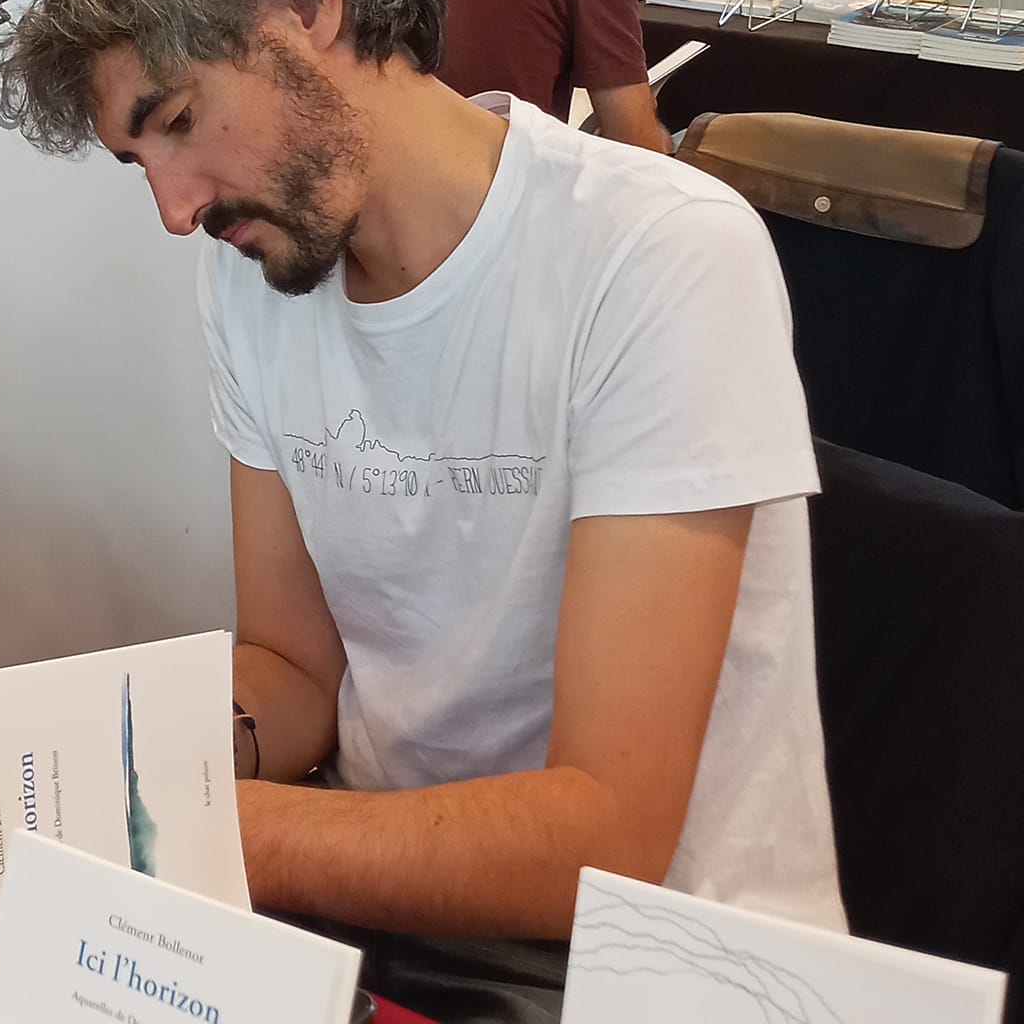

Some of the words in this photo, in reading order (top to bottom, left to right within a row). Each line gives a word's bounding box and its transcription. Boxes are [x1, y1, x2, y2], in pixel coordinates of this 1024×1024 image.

[107, 913, 155, 945] Clément
[157, 933, 205, 965] Bollenot
[75, 939, 107, 976] Ici
[112, 953, 221, 1024] l'horizon
